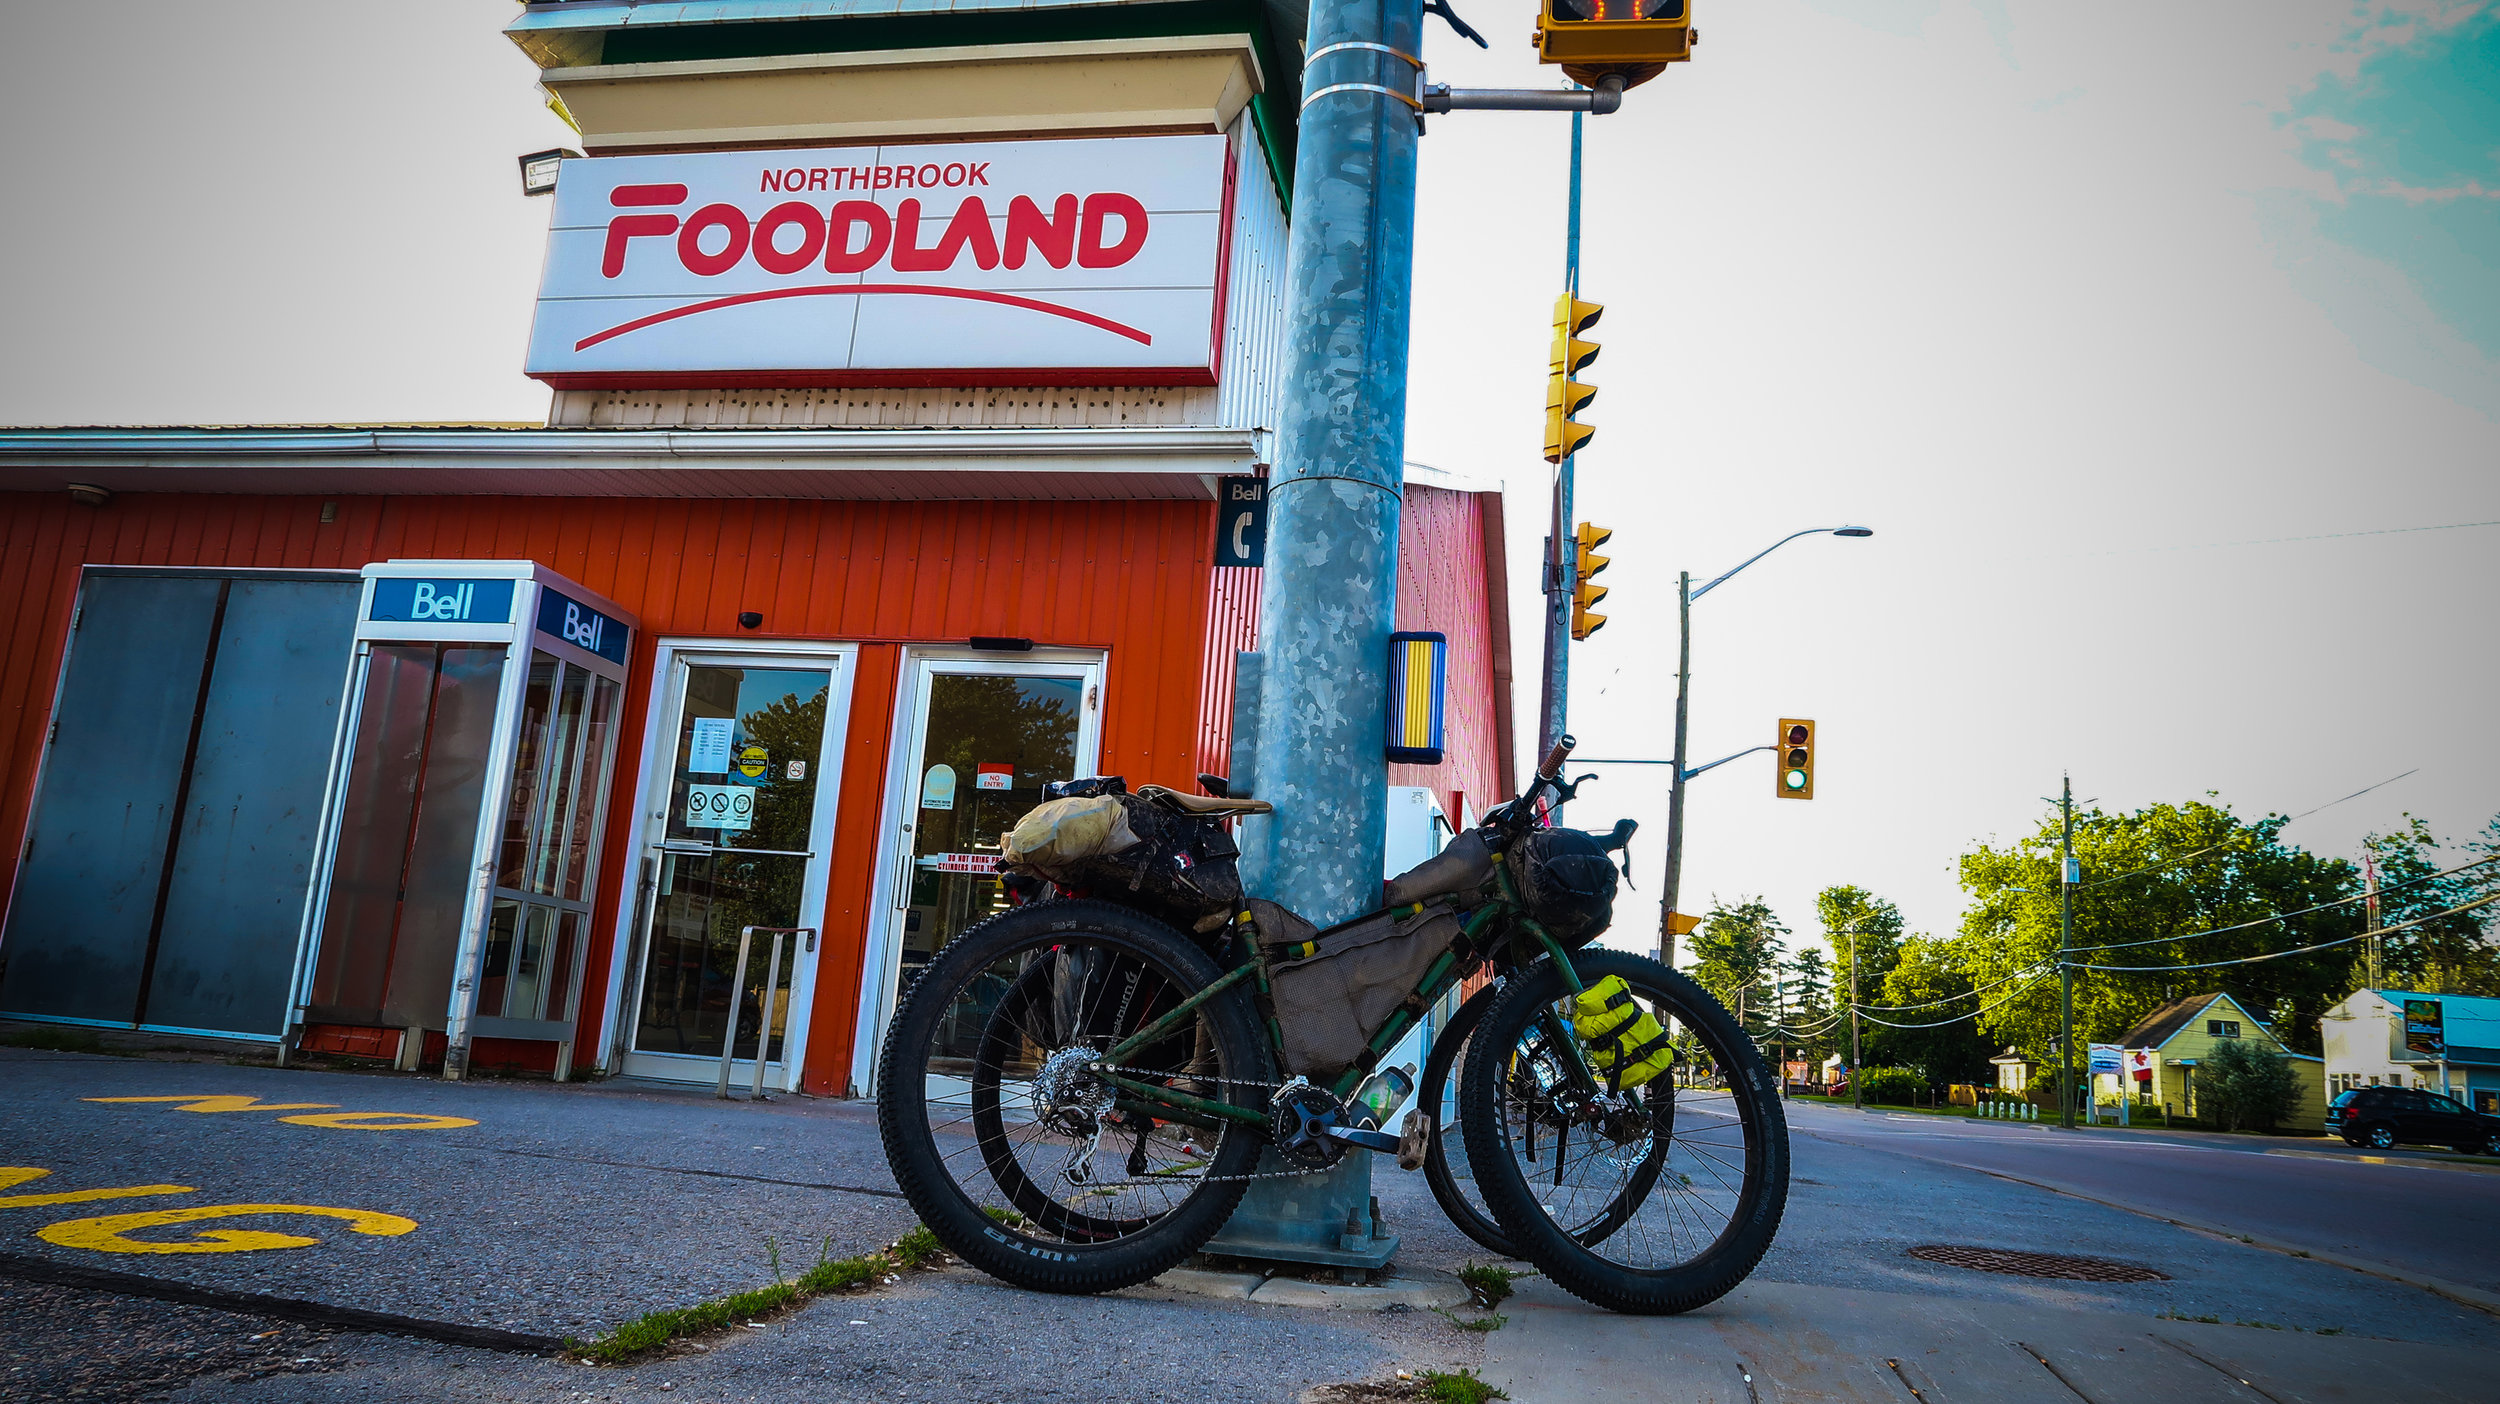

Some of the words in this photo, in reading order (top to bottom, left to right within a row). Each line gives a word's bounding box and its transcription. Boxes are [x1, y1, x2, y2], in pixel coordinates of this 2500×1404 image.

[760, 162, 990, 193] NORTHBROOK
[601, 183, 1149, 279] FOODLAND
[1232, 484, 1262, 501] Bell
[411, 582, 475, 620] Bell
[562, 601, 604, 652] Bell
[937, 862, 969, 871] CYLINDERS
[971, 864, 985, 872] INTO
[948, 854, 956, 862] DO
[983, 1226, 1062, 1262] WTB
